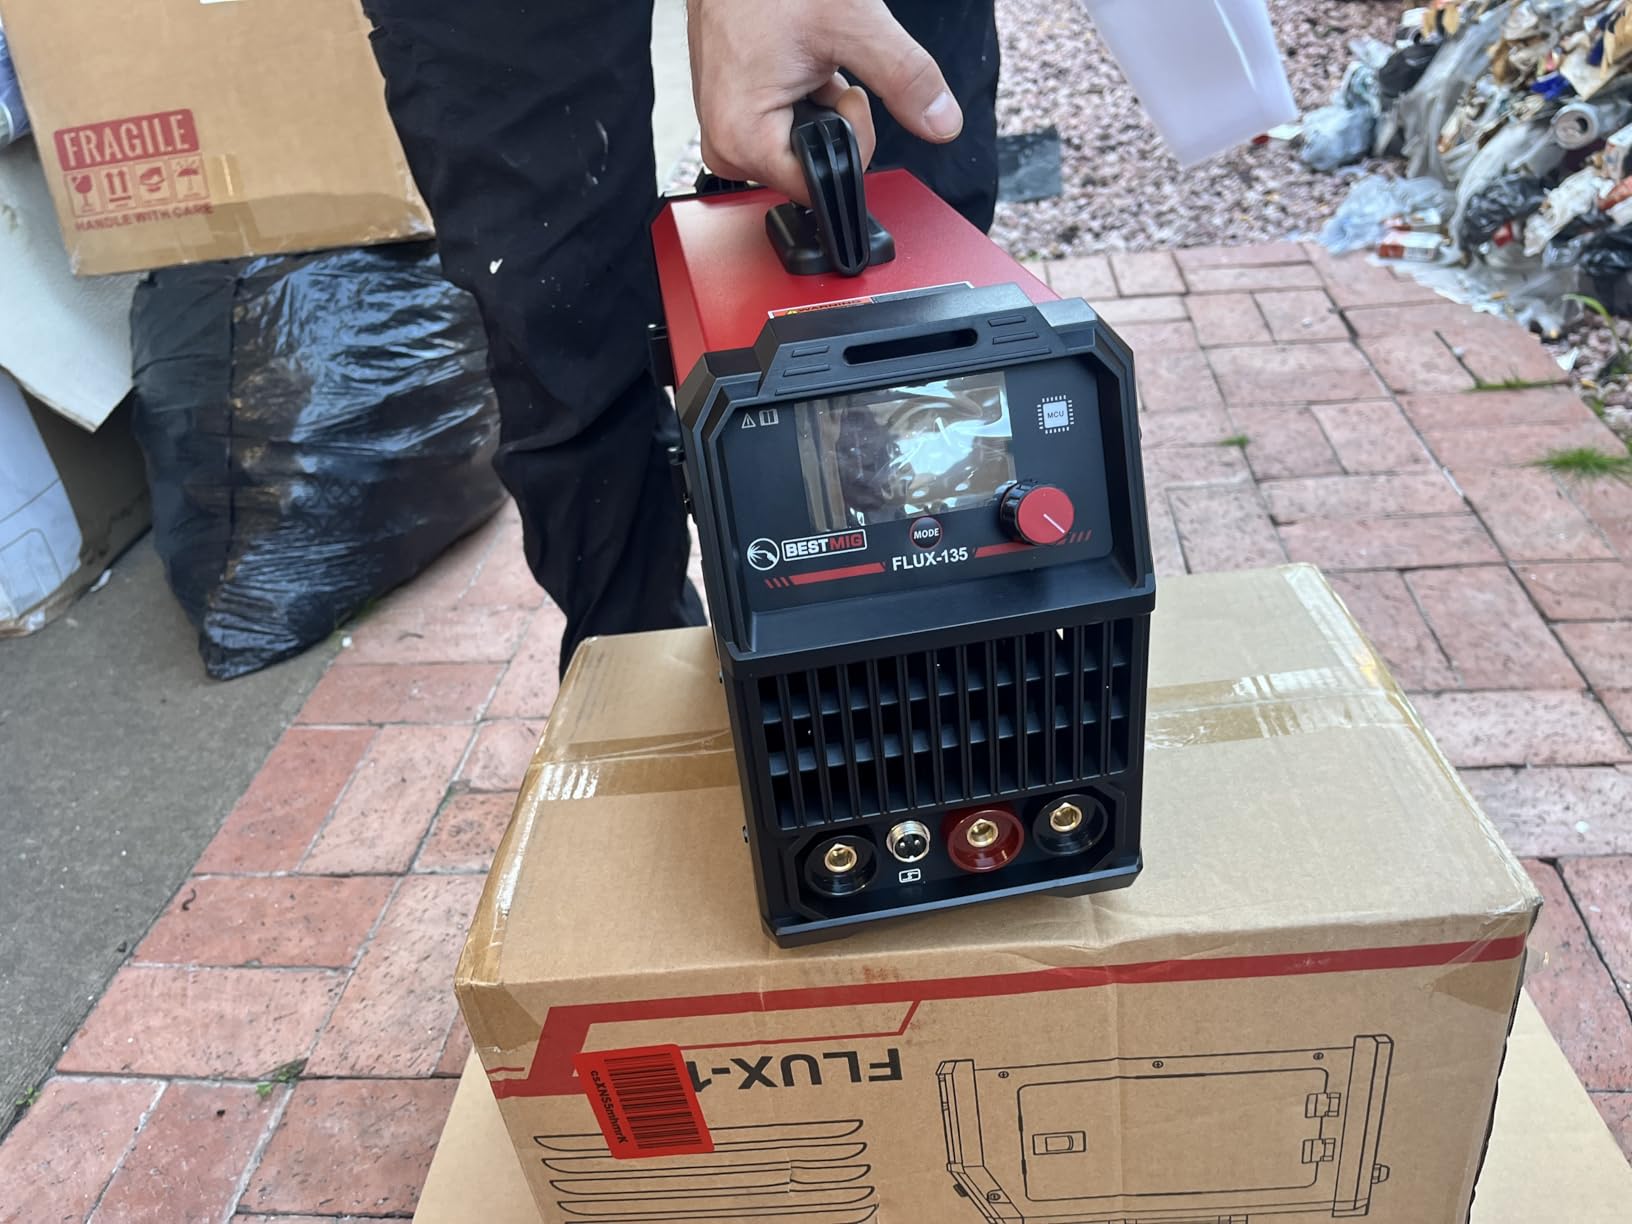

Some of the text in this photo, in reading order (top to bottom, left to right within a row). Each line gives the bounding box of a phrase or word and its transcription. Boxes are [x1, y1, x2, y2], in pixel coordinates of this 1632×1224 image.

[62, 114, 190, 167] FRAGILE
[75, 201, 214, 232] HANDLE WITH CARE
[799, 299, 861, 312] WARNING
[1047, 410, 1064, 419] MCU
[913, 526, 940, 540] MODE
[892, 547, 969, 572] FLUX-135
